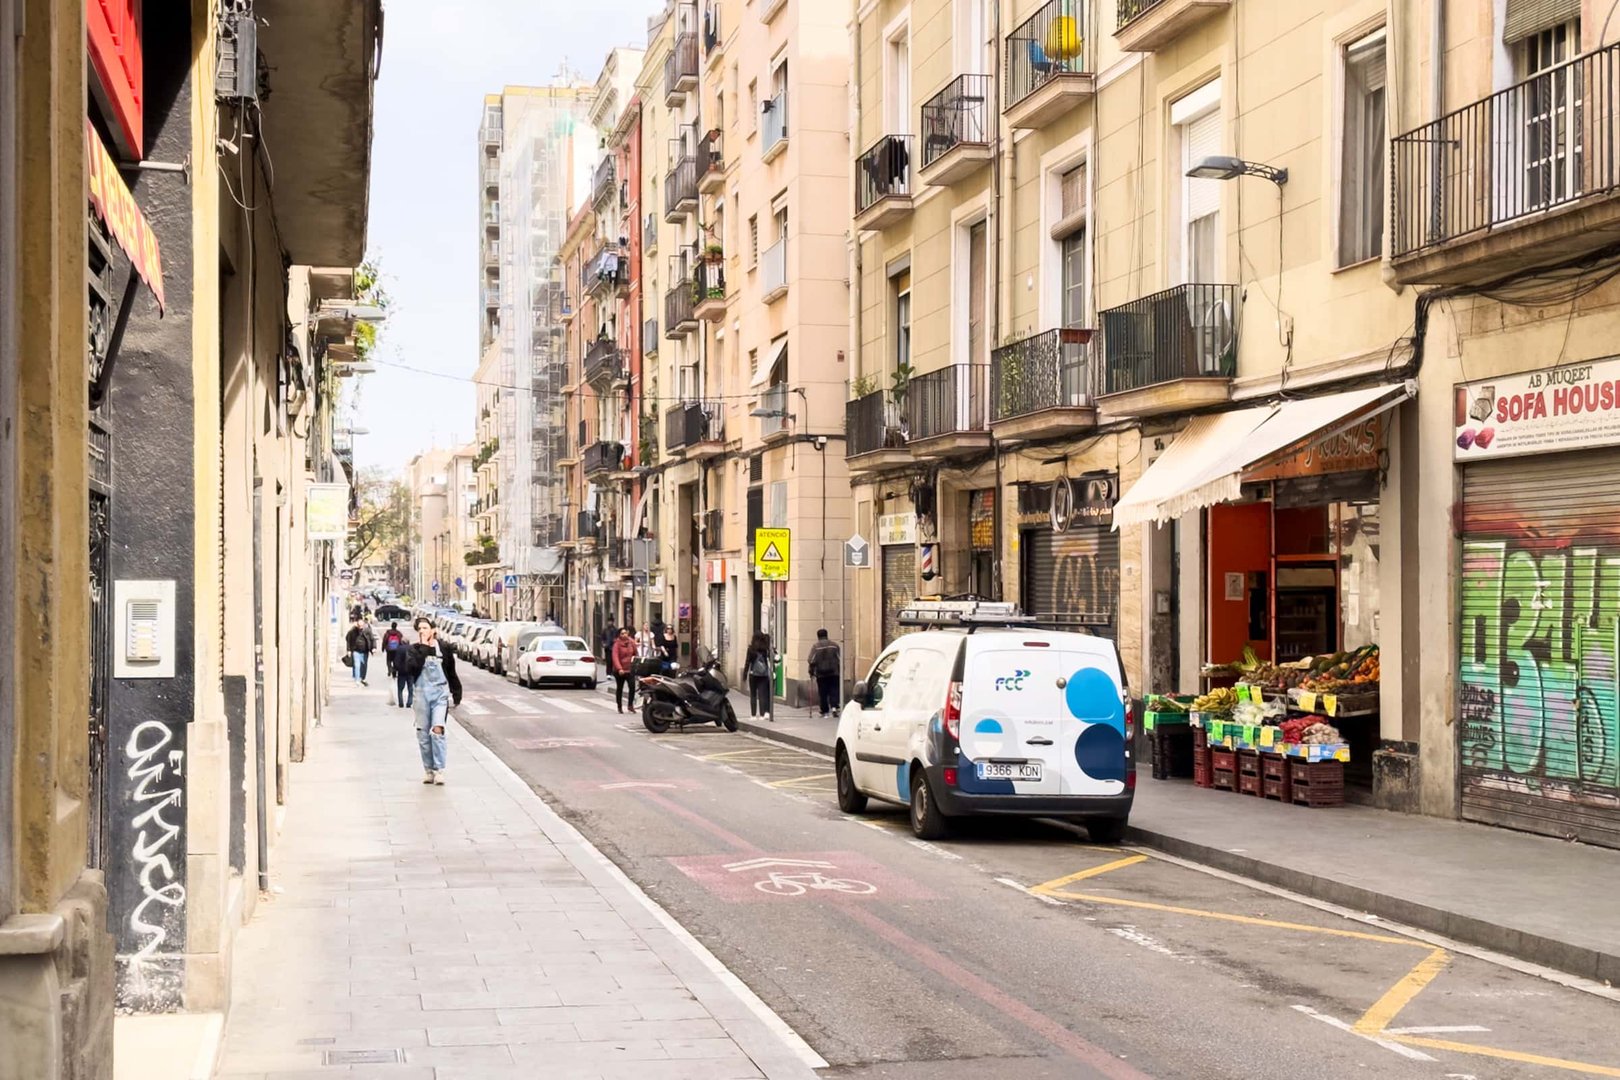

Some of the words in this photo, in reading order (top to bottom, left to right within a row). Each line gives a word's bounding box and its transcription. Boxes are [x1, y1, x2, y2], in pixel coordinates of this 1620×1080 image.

[1528, 372, 1542, 388] AB
[1546, 366, 1593, 386] MUQEET
[1496, 391, 1547, 424] SOFA
[995, 677, 1024, 691] FCC
[986, 765, 1012, 776] 9366
[1019, 765, 1039, 776] KDN
